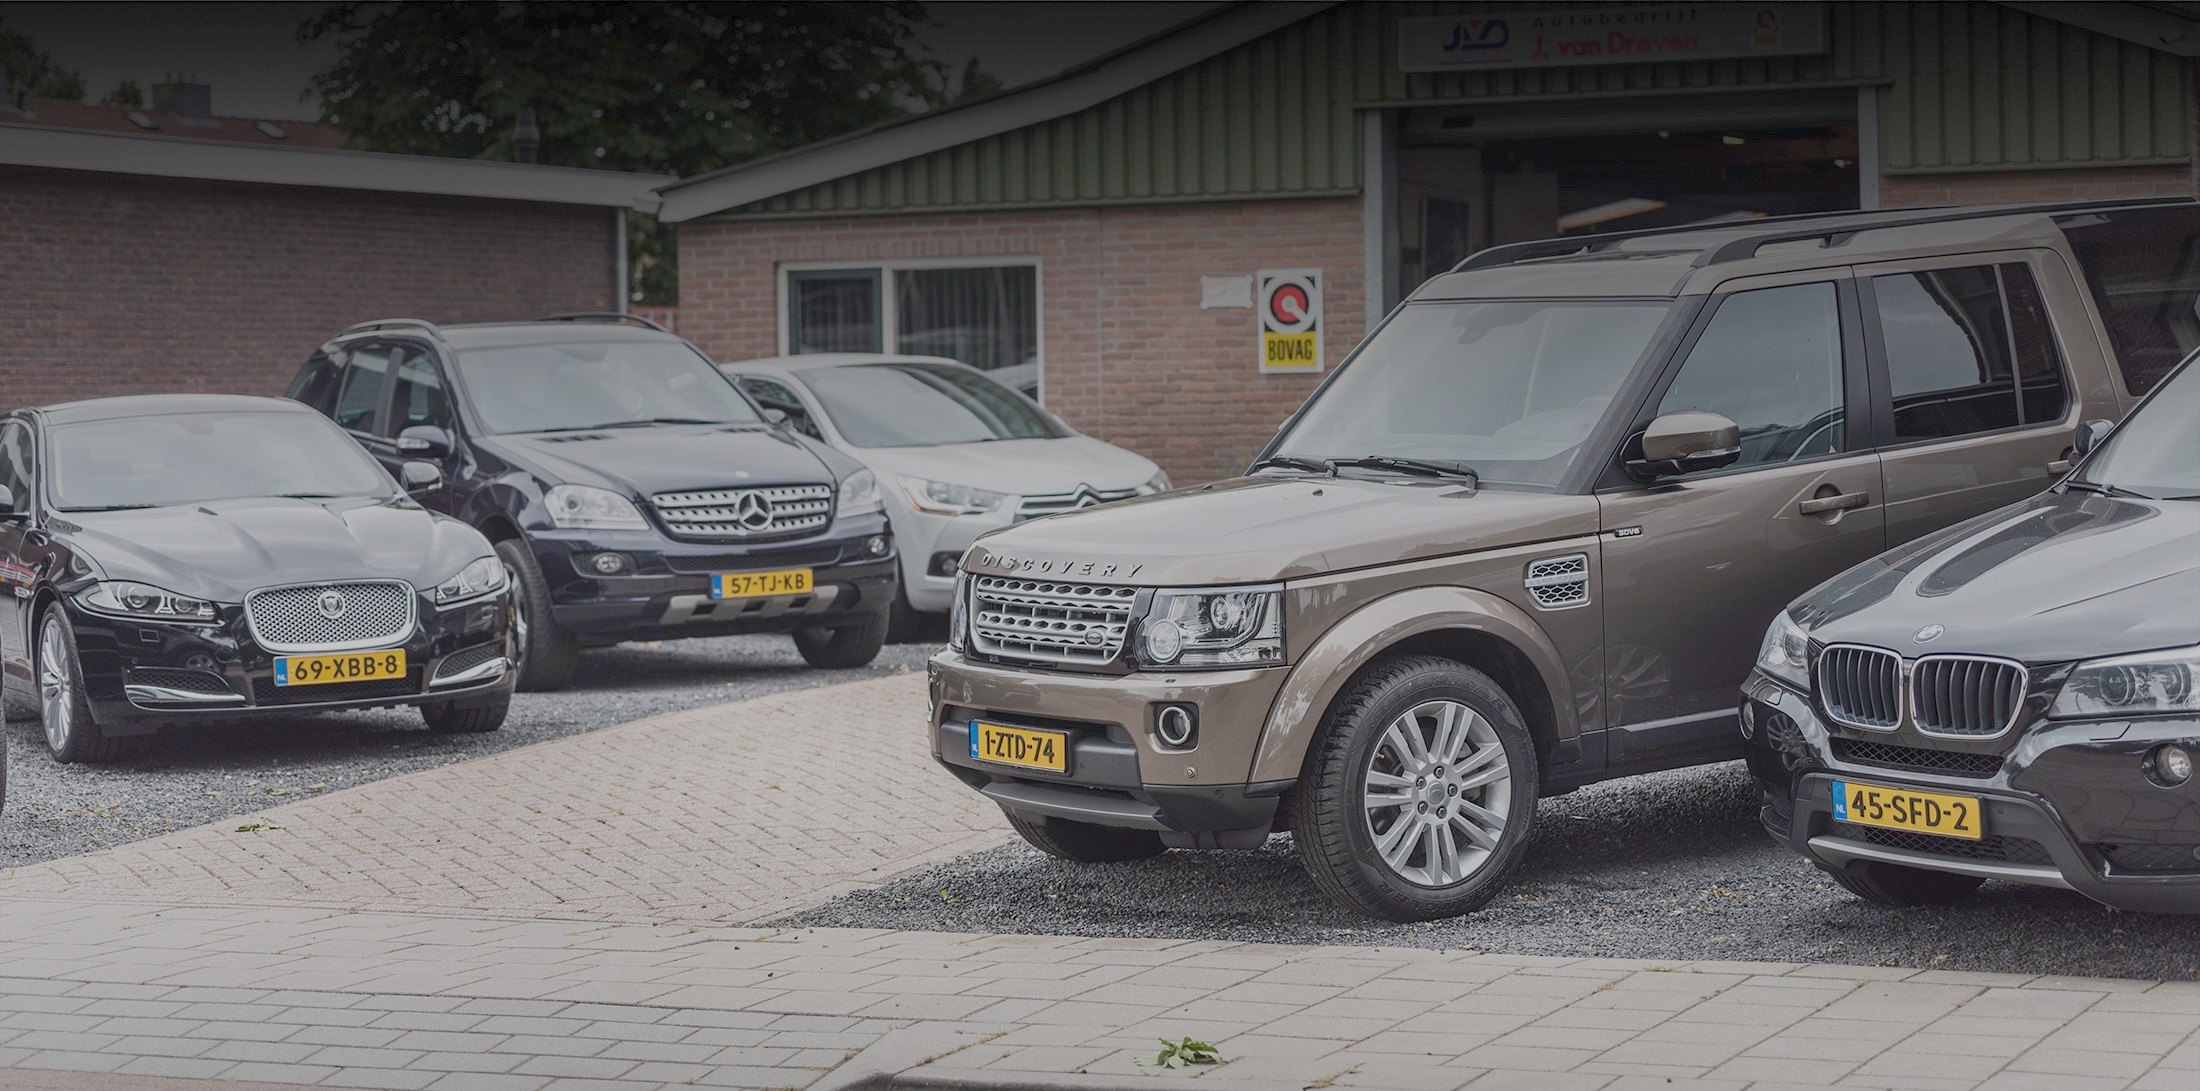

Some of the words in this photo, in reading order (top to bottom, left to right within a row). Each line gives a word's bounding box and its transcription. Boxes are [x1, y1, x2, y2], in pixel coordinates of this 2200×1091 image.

[1531, 34, 1548, 60] J.
[1557, 39, 1601, 56] van
[1607, 31, 1699, 54] Dreven
[1268, 339, 1312, 360] BOVAG
[980, 553, 1144, 578] DISCOVERY
[731, 573, 805, 594] 57-TJ-KB
[295, 655, 398, 681] 69-XBB-8
[984, 729, 1055, 764] 1-ZTD-74
[1835, 803, 1846, 814] NL
[1851, 790, 1969, 831] 45-SFD-2
